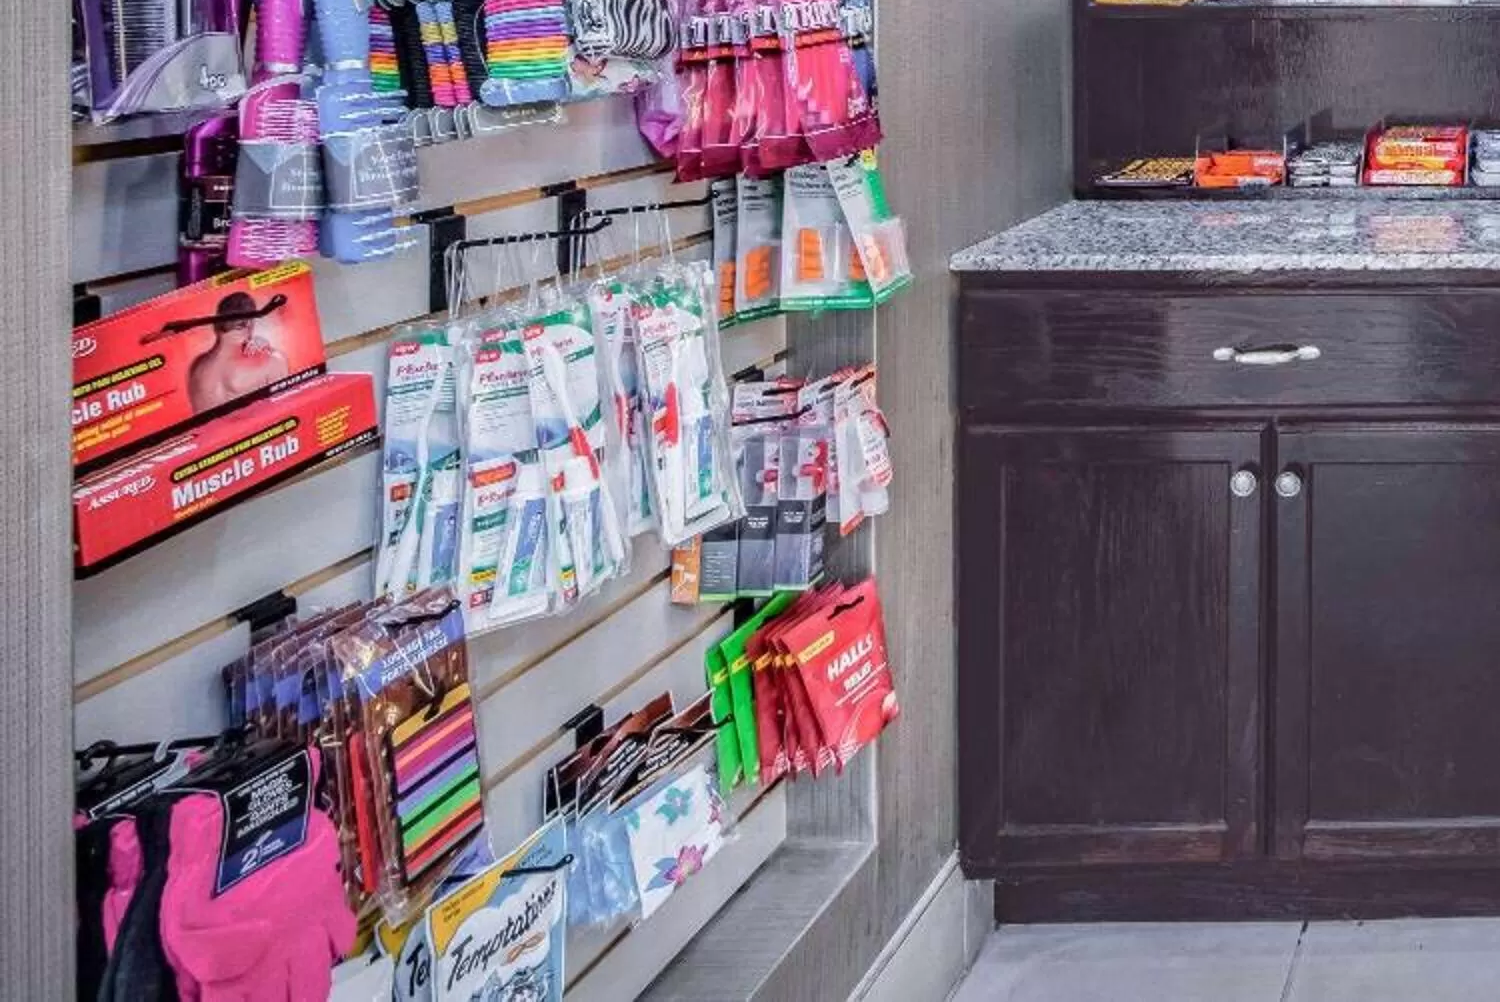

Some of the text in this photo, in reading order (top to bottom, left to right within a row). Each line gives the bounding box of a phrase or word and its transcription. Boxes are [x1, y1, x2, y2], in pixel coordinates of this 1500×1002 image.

[106, 380, 147, 412] Rub
[171, 434, 300, 510] Muscle Rub
[826, 632, 874, 683] HALLS
[240, 847, 258, 874] 2
